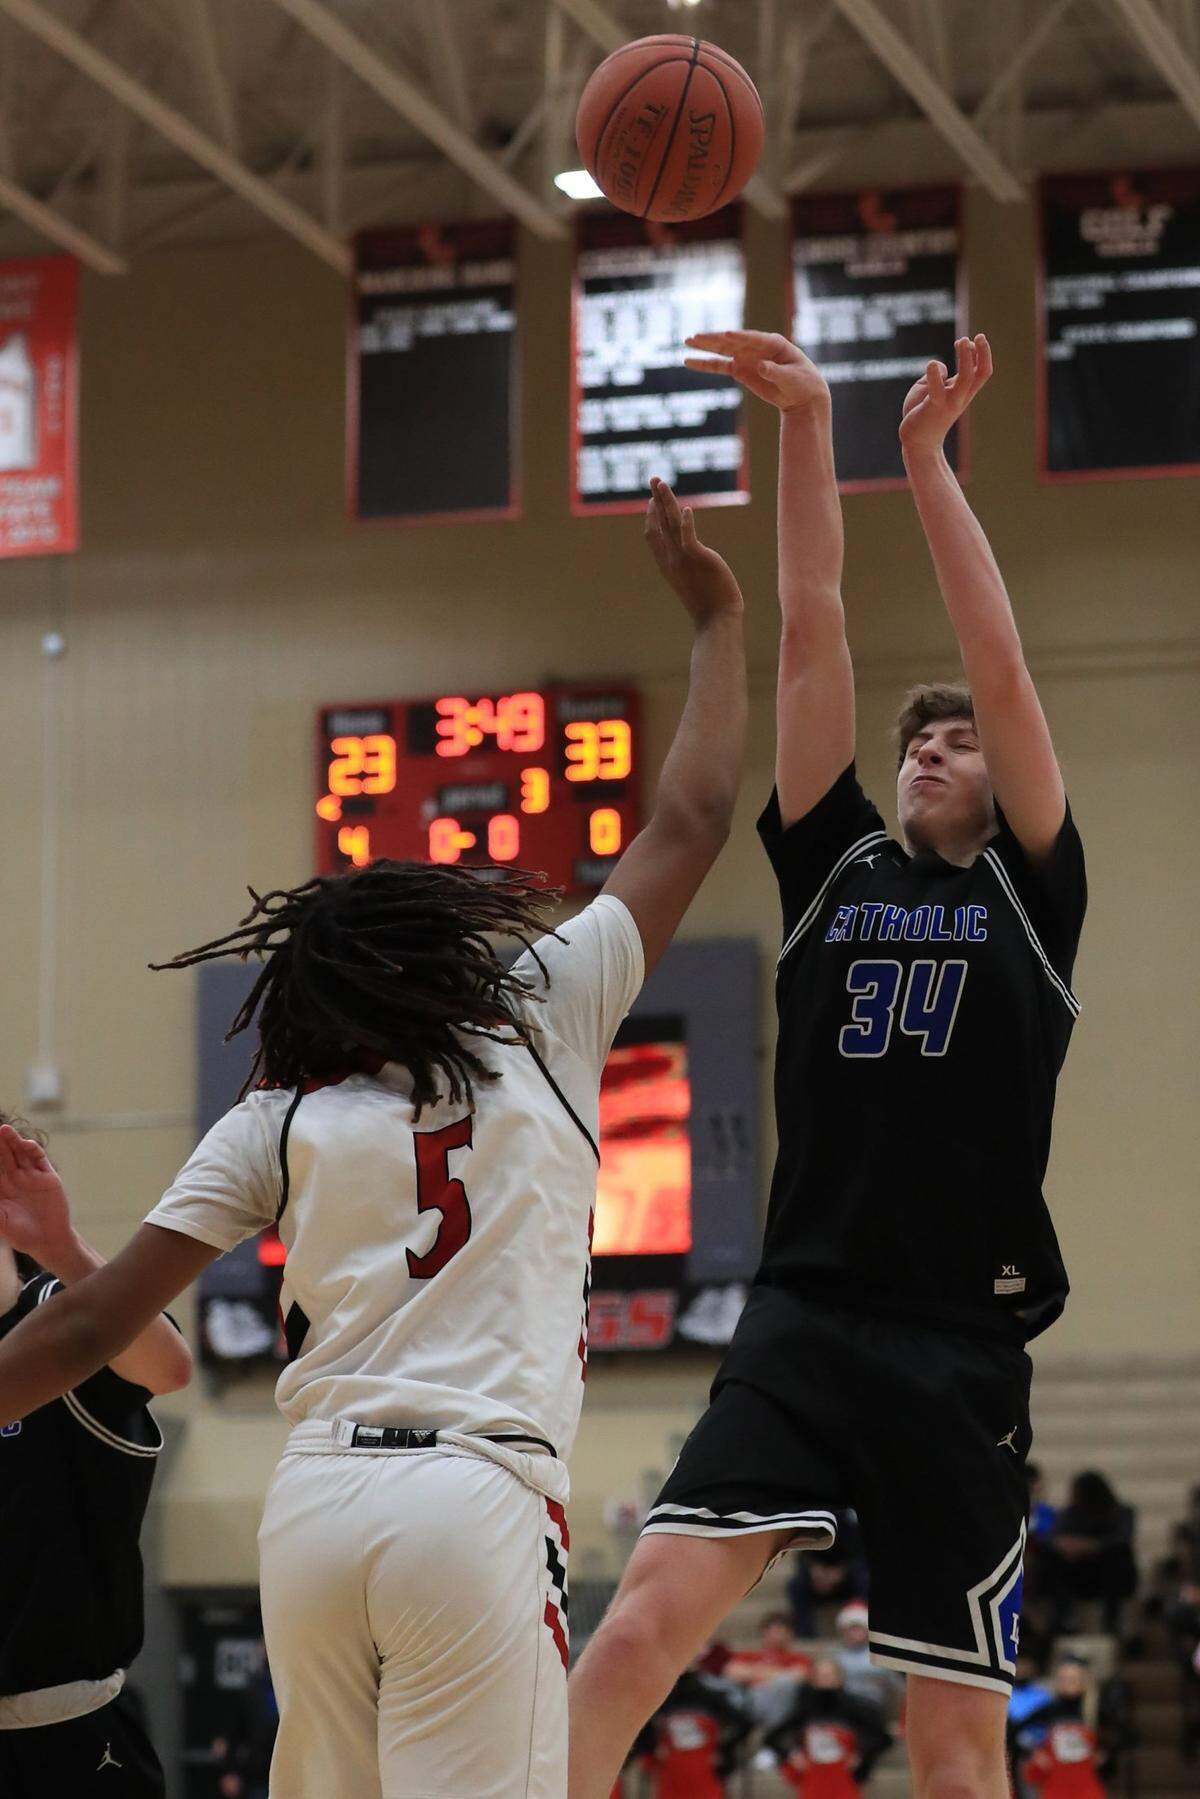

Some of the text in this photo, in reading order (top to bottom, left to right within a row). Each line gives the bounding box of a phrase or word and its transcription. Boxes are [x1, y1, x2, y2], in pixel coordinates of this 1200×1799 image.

[661, 108, 716, 216] SPALDING
[328, 735, 397, 796] 23
[565, 720, 631, 781] 33
[520, 767, 550, 814] 3
[590, 808, 621, 855] 0
[825, 902, 988, 942] CATHOLIC
[838, 959, 968, 1058] 34
[405, 1115, 474, 1279] 5
[1001, 1264, 1021, 1276] XL
